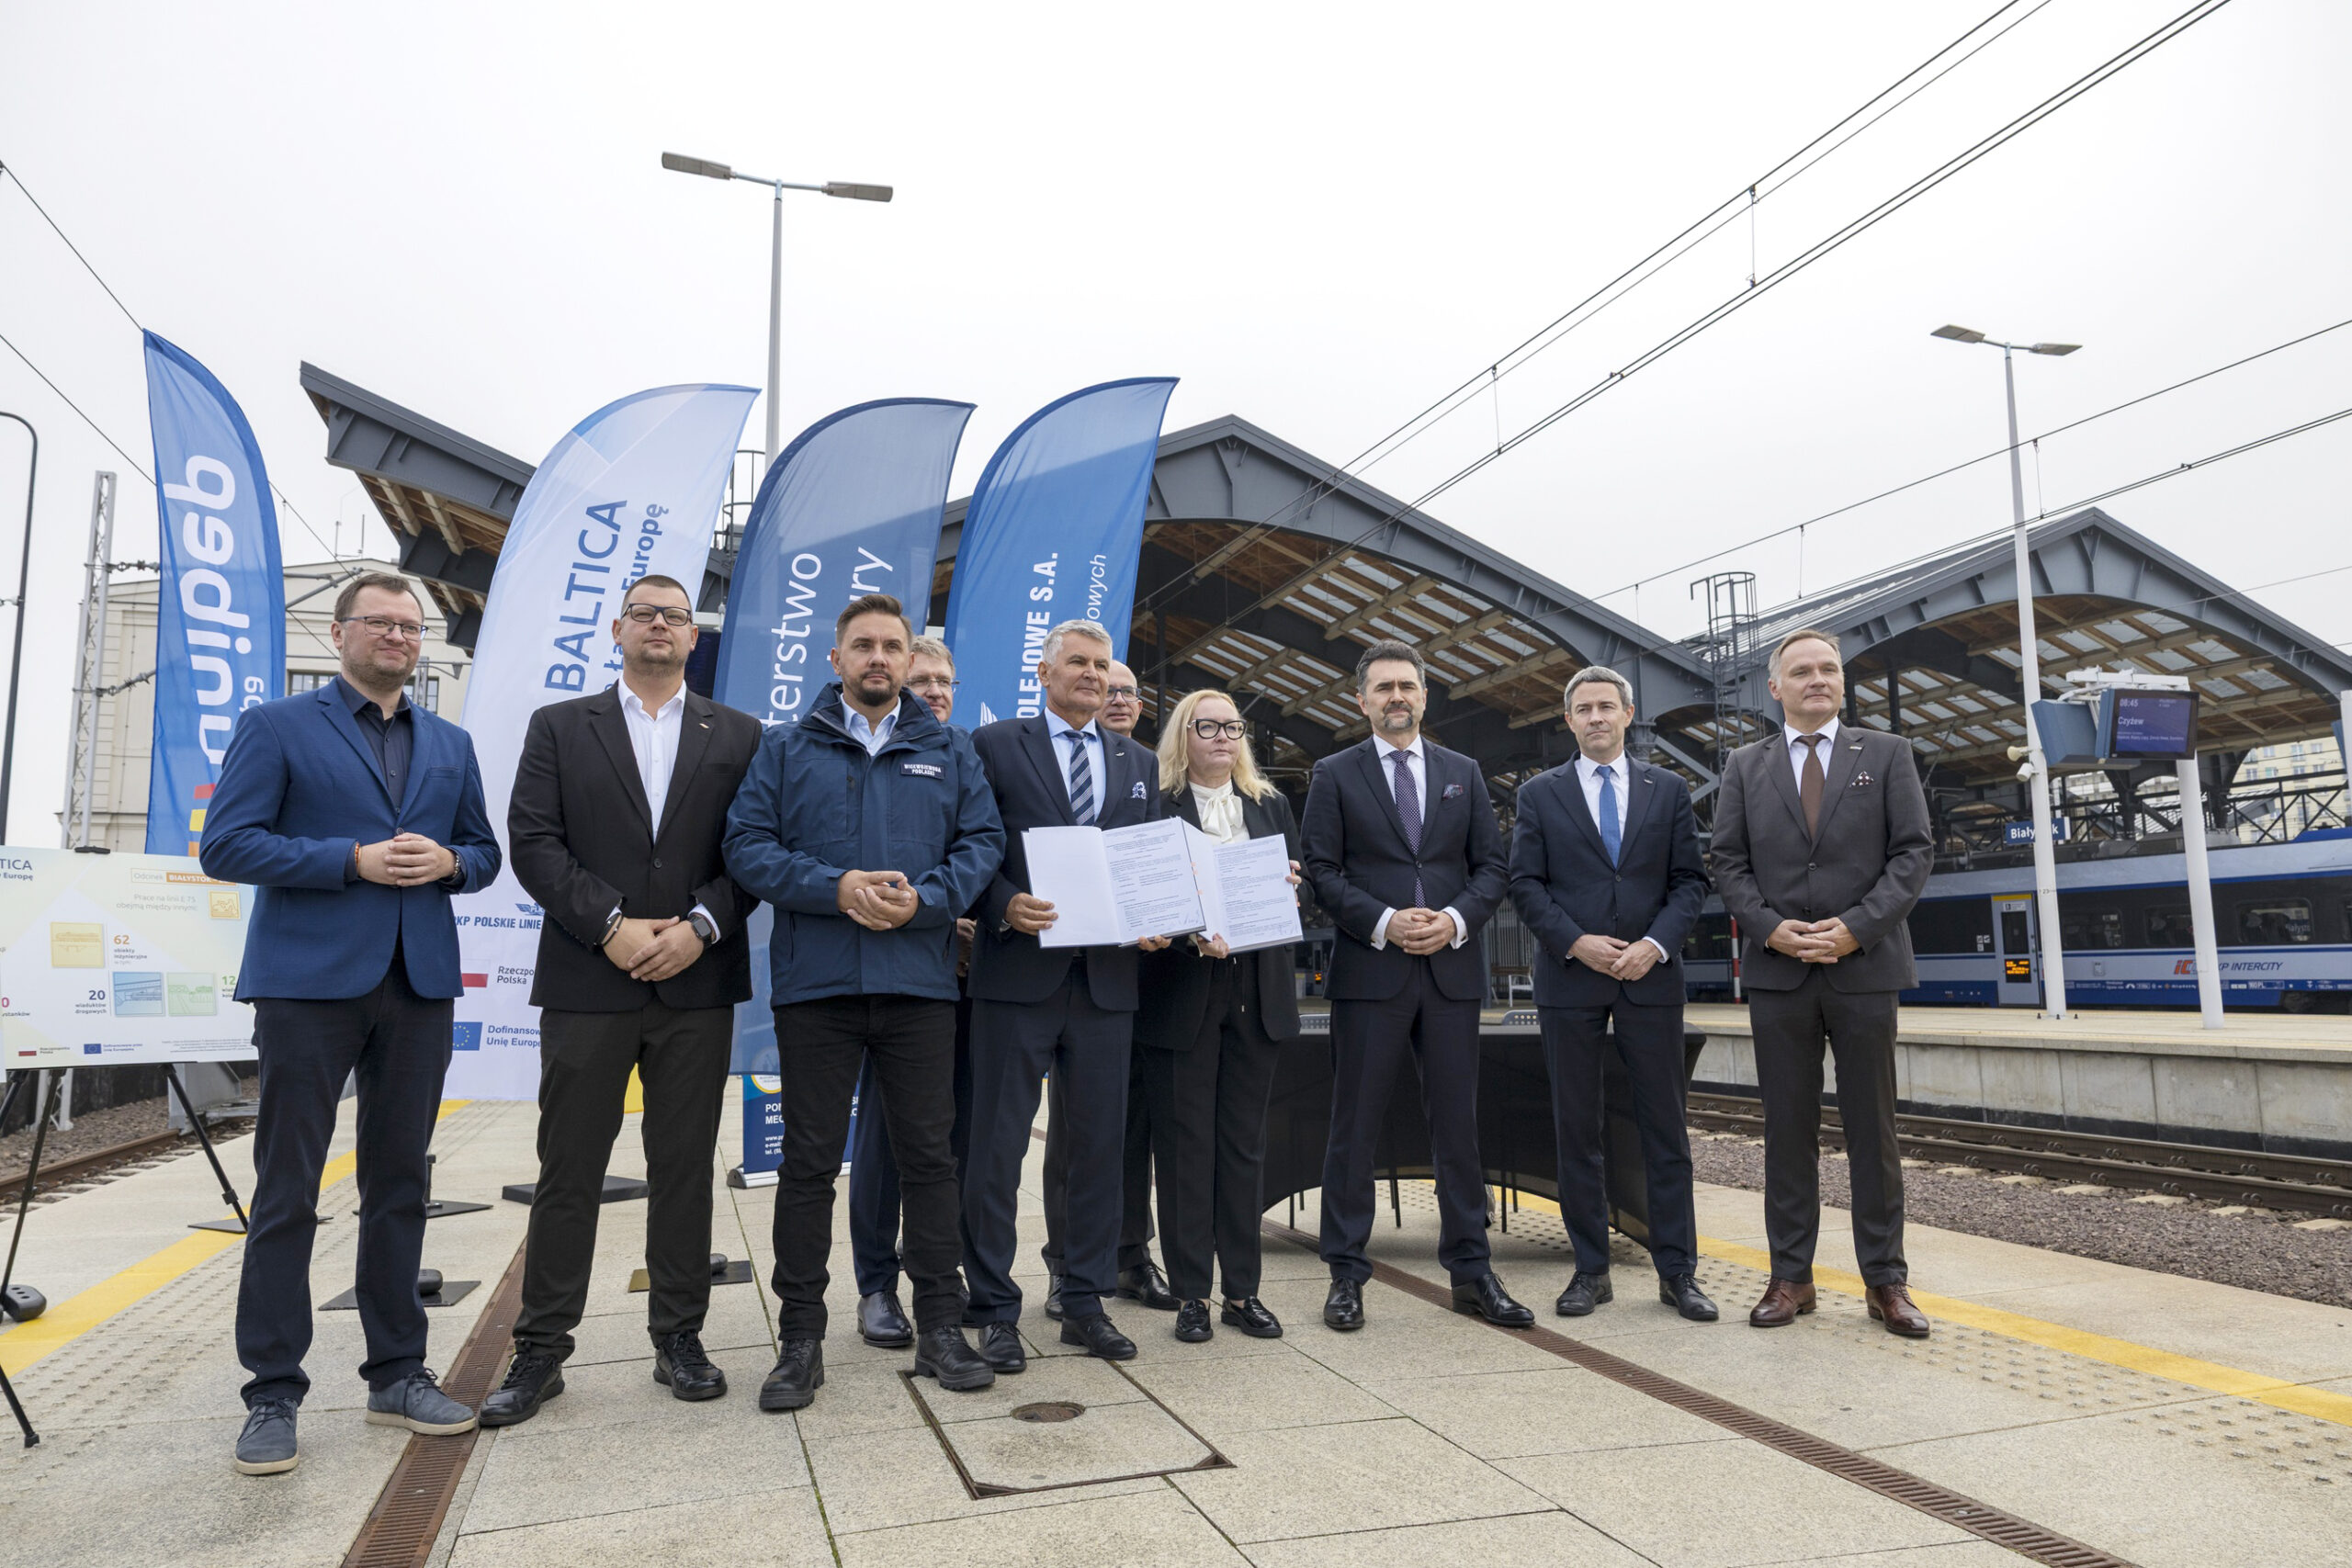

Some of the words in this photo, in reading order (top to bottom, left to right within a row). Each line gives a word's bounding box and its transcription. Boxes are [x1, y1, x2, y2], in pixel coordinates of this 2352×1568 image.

[621, 503, 669, 591] Europę
[1029, 553, 1058, 602] S.A.
[544, 500, 628, 693] BALTICA
[761, 553, 821, 728] terstwo
[1016, 612, 1050, 718] OLEJOWE
[2118, 716, 2145, 727] Czyżew
[2010, 823, 2059, 840] Białyk
[0, 859, 32, 871] TICA
[474, 917, 516, 929] POLSKIE
[519, 919, 541, 930] LINIE
[113, 934, 130, 945] 62
[497, 965, 535, 976] Rzeczpo
[2231, 962, 2283, 971] INTERCITY
[221, 976, 236, 986] 12
[496, 976, 527, 985] Polska
[88, 989, 106, 1000] 20
[488, 1024, 541, 1035] Dofinansow
[486, 1036, 507, 1048] Unię
[507, 1037, 541, 1048] Europ
